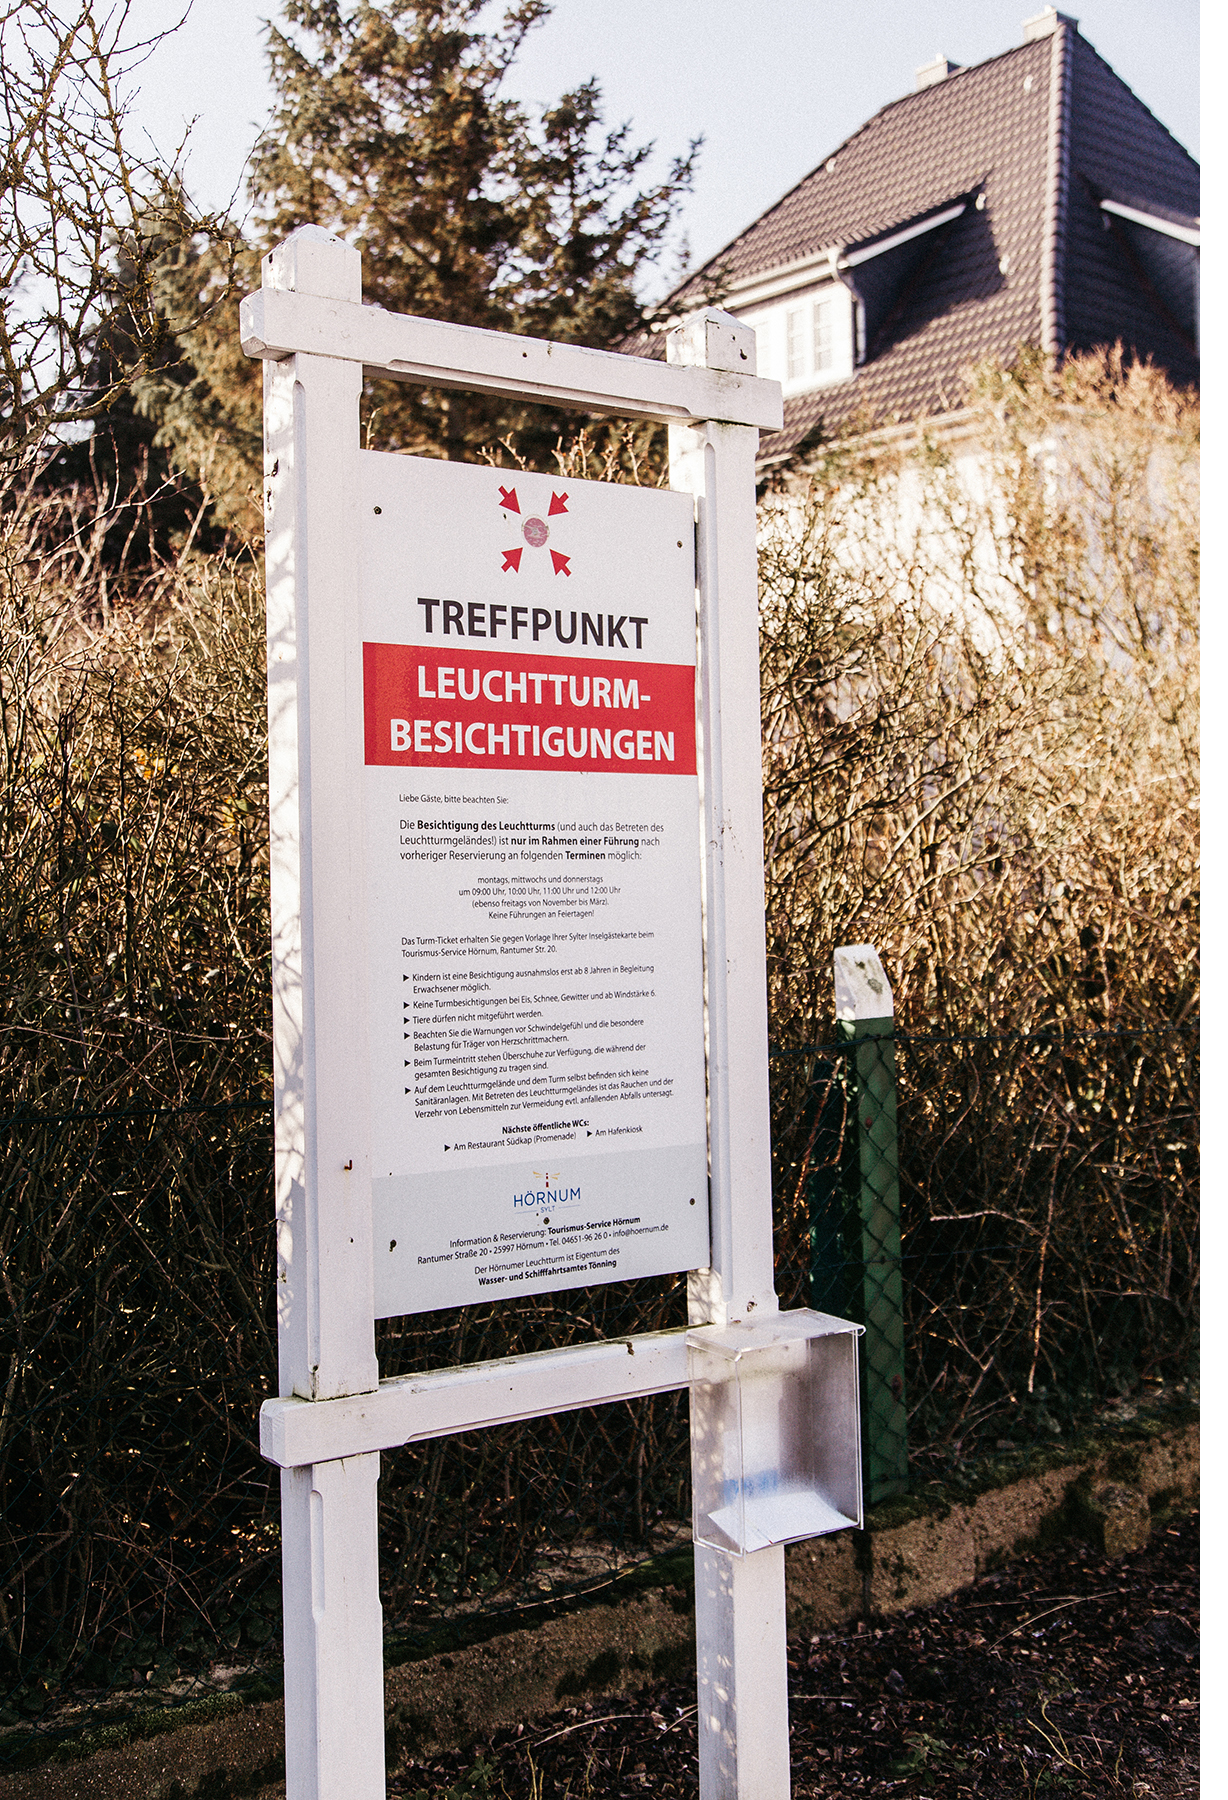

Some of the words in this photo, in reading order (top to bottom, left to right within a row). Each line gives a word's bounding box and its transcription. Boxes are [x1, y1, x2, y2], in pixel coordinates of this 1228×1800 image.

[417, 598, 648, 650] TREFFPUNKT
[418, 666, 650, 710] LEUCHTTURM-
[390, 719, 675, 761] BESICHTIGUNGEN
[398, 793, 419, 802] Liebe
[420, 794, 442, 803] Gäste,
[443, 794, 461, 803] bitte
[462, 795, 495, 804] beachten
[496, 795, 508, 804] Sie:
[399, 819, 415, 829] Die
[417, 819, 478, 832] Besichtigung
[480, 820, 497, 830] des
[498, 820, 555, 830] Leuchtturms
[556, 822, 576, 831] (und
[577, 822, 598, 831] auch
[599, 822, 613, 831] das
[615, 822, 648, 831] Betreten
[650, 823, 664, 832] des
[498, 835, 508, 845] ist
[528, 835, 540, 845] im
[541, 835, 578, 845] Rahmen
[579, 836, 602, 845] einer
[603, 836, 639, 848] Führung
[641, 837, 660, 846] nach
[399, 850, 447, 862] vorheriger
[448, 850, 506, 862] Reservierung
[507, 852, 518, 860] an
[520, 850, 563, 862] folgenden
[564, 850, 606, 859] Terminen
[607, 850, 642, 862] möglich:
[401, 936, 415, 945] Das
[415, 936, 458, 945] Turm-Ticket
[459, 935, 489, 944] erhalten
[490, 934, 500, 943] Sie
[501, 935, 524, 944] gegen
[524, 933, 550, 943] Vorlage
[551, 933, 567, 941] Ihrer
[568, 932, 587, 942] Sylter
[588, 931, 637, 941] Inselgästekarte
[401, 947, 466, 957] Tourismus-Service
[467, 947, 498, 955] Hörnum,
[499, 946, 533, 954] Rantumer
[534, 945, 546, 953] Str.
[547, 944, 557, 952] 20.
[412, 972, 441, 981] Kindern
[442, 972, 450, 980] ist
[451, 971, 468, 980] eine
[468, 970, 514, 980] Besichtigung
[515, 968, 559, 977] ausnahmslos
[583, 966, 588, 974] 8
[589, 966, 611, 974] Jahren
[619, 964, 654, 974] Begleitung
[413, 984, 459, 994] Erwachsener
[460, 982, 491, 993] möglich.
[412, 1000, 433, 1009] Keine
[434, 998, 507, 1008] Turmbesichtigungen
[508, 996, 520, 1004] bei
[521, 995, 532, 1003] Eis,
[533, 994, 559, 1003] Schnee,
[560, 993, 589, 1001] Gewitter
[590, 991, 603, 1000] und
[604, 991, 613, 999] ab
[613, 989, 649, 998] Windstärke
[412, 1015, 430, 1024] Tiere
[431, 1013, 456, 1023] dürfen
[457, 1013, 475, 1021] nicht
[476, 1011, 514, 1022] mitgeführt
[515, 1009, 543, 1018] werden.
[413, 1030, 447, 1039] Beachten
[448, 1028, 459, 1037] Sie
[460, 1028, 472, 1036] die
[472, 1027, 514, 1036] Warnungen
[527, 1021, 583, 1032] Schwindelgefühl
[584, 1020, 597, 1028] und
[598, 1020, 609, 1028] die
[610, 1018, 644, 1027] besondere
[413, 1084, 427, 1094] Auf
[428, 1084, 445, 1093] dem
[446, 1078, 515, 1091] Leuchtturmgelände
[516, 1077, 530, 1086] und
[531, 1076, 547, 1084] dem
[548, 1075, 566, 1083] Turm
[567, 1073, 586, 1082] selbst
[587, 1071, 617, 1080] befinden
[617, 1069, 630, 1078] sich
[414, 1095, 470, 1106] Sanitäranlagen.
[471, 1093, 483, 1101] Mit
[484, 1092, 514, 1100] Betreten
[515, 1089, 528, 1098] des
[529, 1084, 598, 1096] Leuchtturmgeländes
[607, 1082, 619, 1090] das
[620, 1080, 648, 1088] Rauchen
[648, 1078, 662, 1086] und
[414, 1108, 442, 1118] Verzehr
[458, 1102, 509, 1114] Lebensmitteln
[521, 1098, 563, 1108] Vermeidung
[580, 1093, 618, 1104] anfallenden
[619, 1091, 641, 1100] Abfalls
[642, 1089, 673, 1098] untersagt.
[502, 1125, 531, 1134] Nächste
[532, 1120, 571, 1131] öffentliche
[571, 1119, 589, 1127] WCs:
[607, 1125, 643, 1135] Hafenkiosk
[453, 1143, 466, 1151] Am
[467, 1139, 504, 1149] Restaurant
[506, 1136, 532, 1146] Südkap
[513, 1187, 580, 1207] HÖRNUM
[540, 1205, 555, 1213] SYLT
[449, 1236, 491, 1247] Information
[492, 1234, 498, 1242] &
[499, 1229, 546, 1241] Reservierung:
[547, 1220, 611, 1234] Tourismus-Service
[612, 1217, 640, 1226] Hörnum
[417, 1253, 453, 1264] Rantumer
[454, 1248, 477, 1259] Straße
[479, 1247, 488, 1256] 20
[493, 1243, 514, 1254] 25997
[515, 1241, 544, 1250] Hörnum
[549, 1237, 560, 1246] Tel.
[561, 1233, 592, 1244] 04651-96
[594, 1232, 602, 1240] 26
[602, 1231, 608, 1239] 0
[612, 1223, 668, 1237] info@hoernum.de
[474, 1266, 487, 1274] Der
[488, 1261, 524, 1272] Hörnumer
[525, 1256, 565, 1267] Leuchtturm
[566, 1253, 574, 1261] ist
[575, 1250, 607, 1261] Eigentum
[608, 1247, 620, 1255] des
[478, 1276, 507, 1285] Wasser-
[508, 1271, 523, 1281] und
[588, 1259, 617, 1269] Tönning
